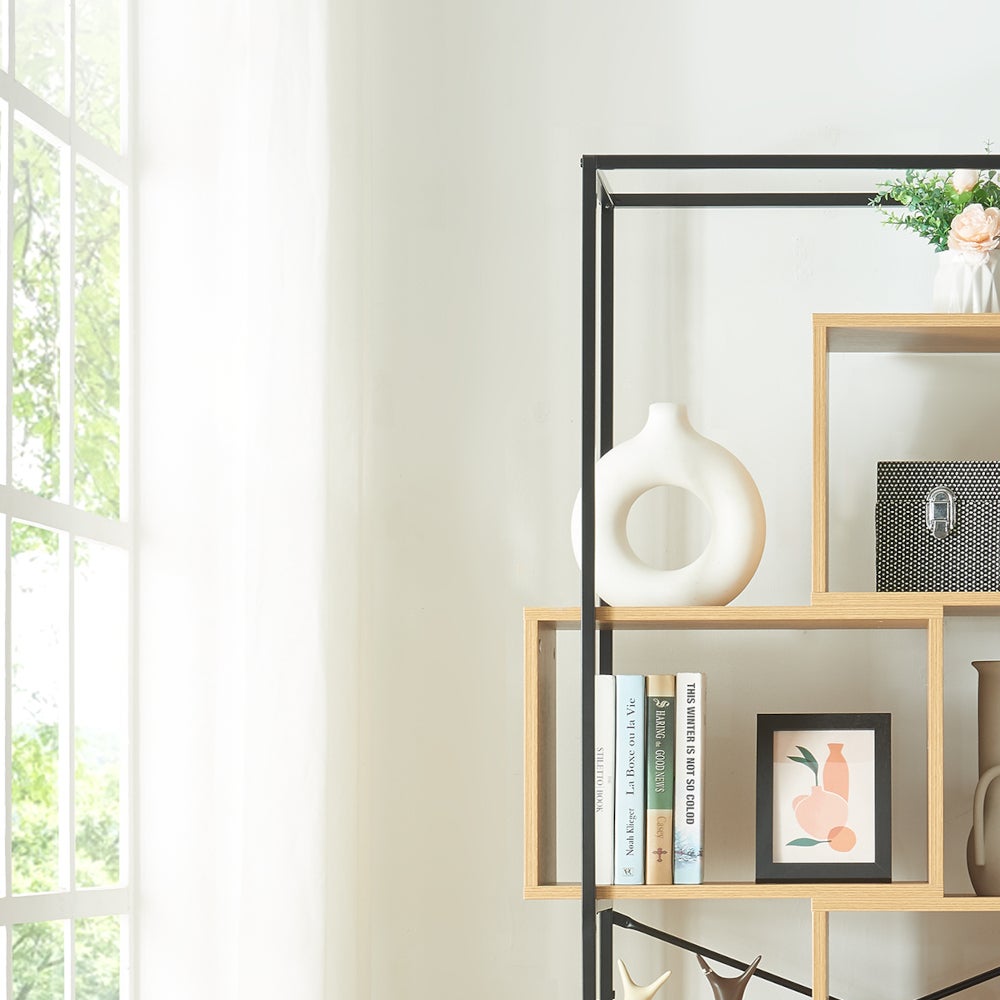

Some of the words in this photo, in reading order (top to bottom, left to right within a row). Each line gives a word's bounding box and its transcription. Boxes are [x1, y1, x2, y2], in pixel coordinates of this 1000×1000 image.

[686, 683, 696, 704] THIS
[626, 697, 636, 716] Vie
[626, 719, 636, 730] la
[686, 706, 696, 742] WINTER
[627, 733, 636, 746] ou
[686, 745, 696, 755] IS
[626, 749, 636, 777] Boxe
[655, 749, 666, 771] GOOD
[686, 757, 696, 776] NOT
[626, 781, 636, 795] La
[655, 771, 665, 793] NEWS
[685, 778, 695, 791] SO
[685, 794, 695, 825] COLOD
[626, 808, 636, 833] Klieger
[655, 816, 667, 839] Casey
[626, 835, 635, 856] Noah
